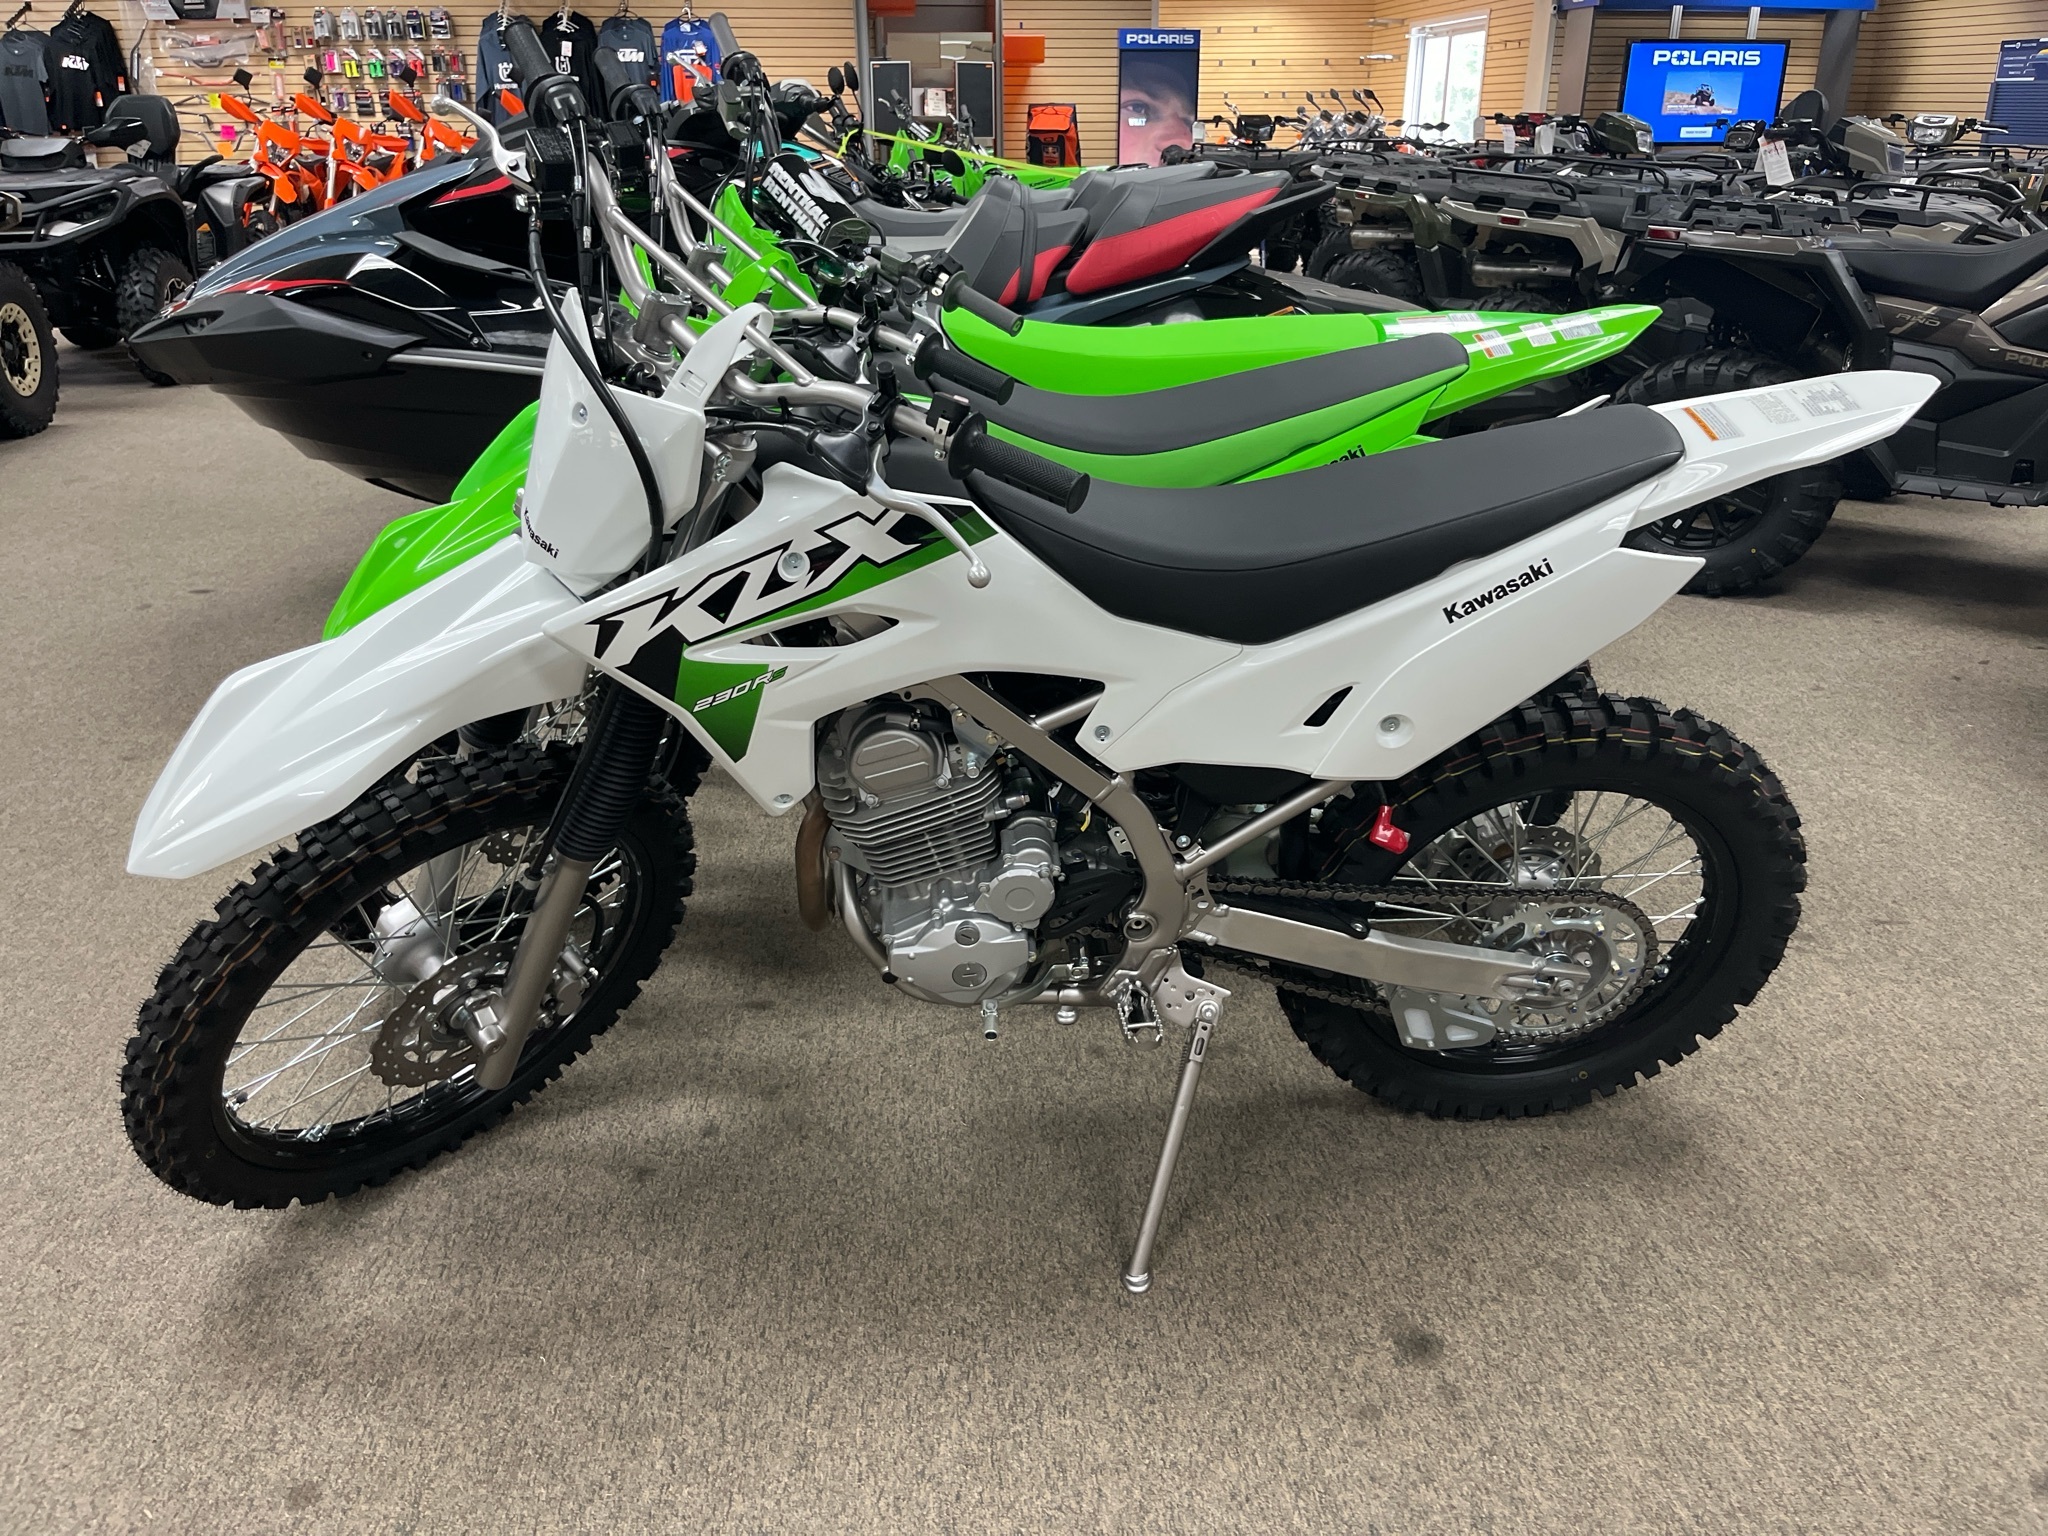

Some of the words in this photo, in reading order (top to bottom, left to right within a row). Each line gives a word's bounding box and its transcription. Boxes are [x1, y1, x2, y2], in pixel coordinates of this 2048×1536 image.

[1126, 34, 1194, 44] POLARIS
[617, 48, 645, 63] KTM
[1653, 50, 1761, 66] POLARIS
[762, 176, 821, 244] RENTHAL
[1896, 312, 1941, 327] AWD
[524, 506, 560, 559] Kawasaki
[1442, 557, 1554, 624] Kawasaki
